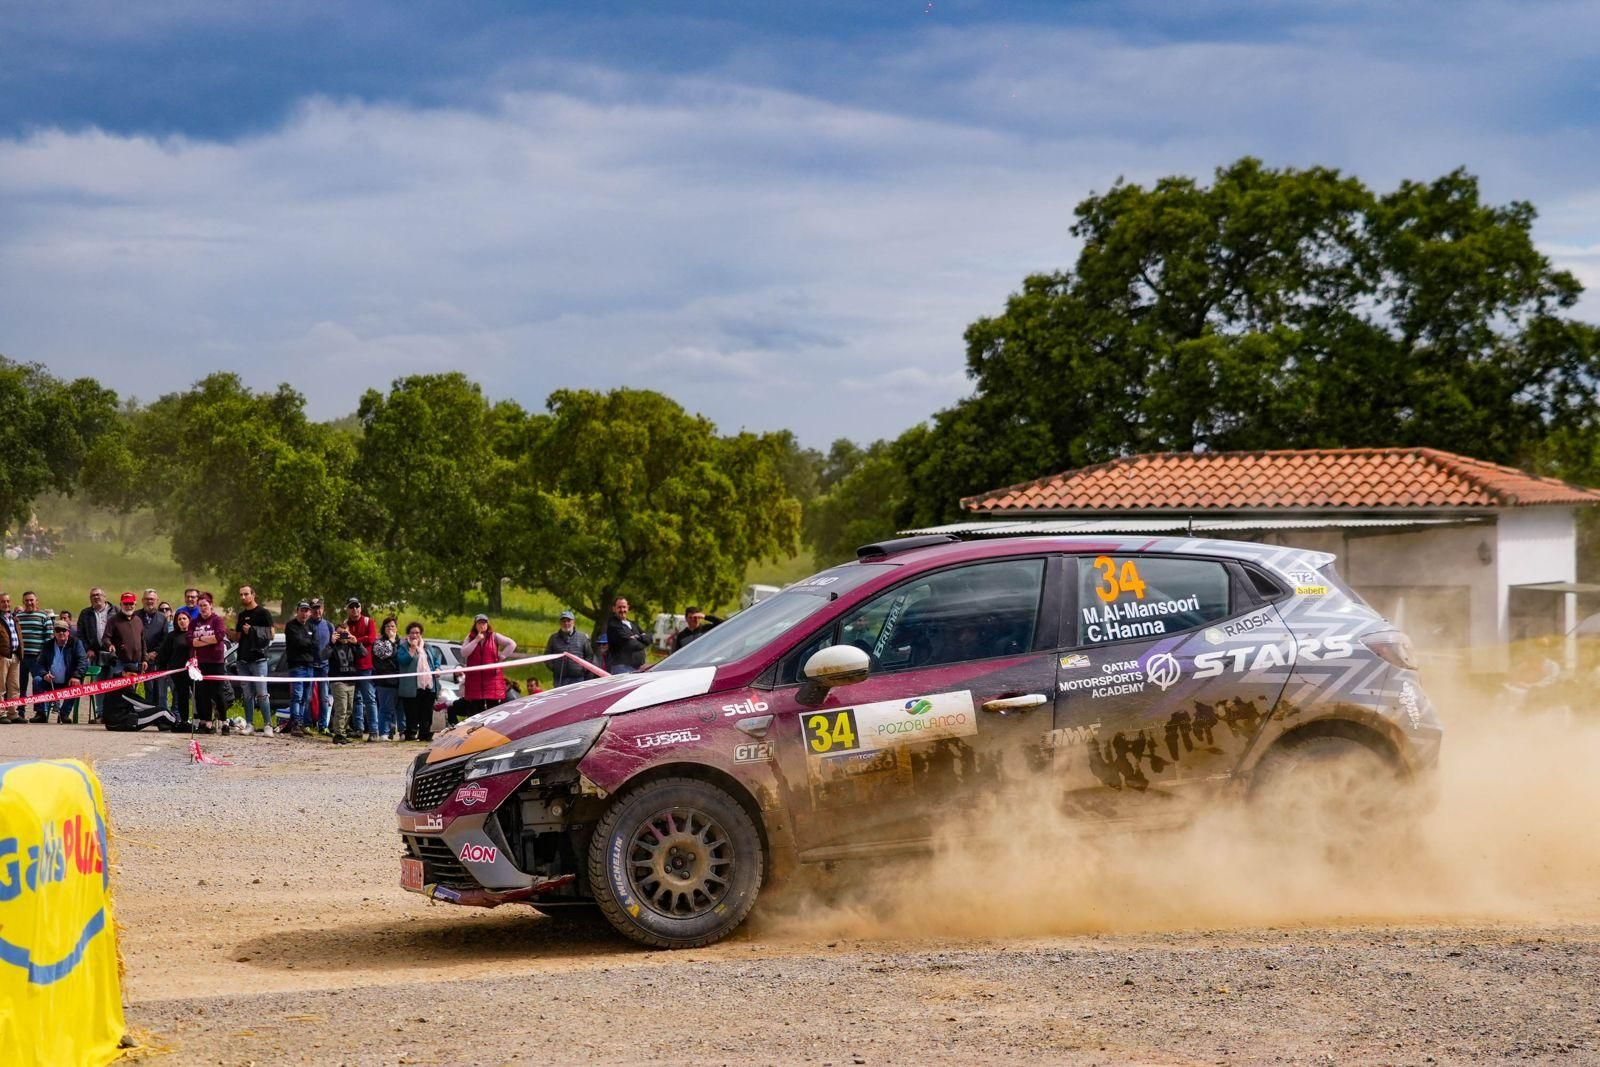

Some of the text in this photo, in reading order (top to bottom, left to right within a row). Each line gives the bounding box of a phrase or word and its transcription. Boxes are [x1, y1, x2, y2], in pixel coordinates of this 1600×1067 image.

[1093, 555, 1146, 603] 34
[1082, 594, 1200, 624] M.Al-Mansoori
[1087, 620, 1166, 642] C.Hanna
[1224, 612, 1273, 637] RADSA
[1102, 660, 1140, 674] QATAR
[1192, 634, 1353, 680] STARS
[83, 684, 99, 693] ZONA
[1059, 671, 1144, 692] MOTORSPORTS
[1092, 682, 1145, 699] ACADEMY
[808, 711, 855, 753] 34
[878, 713, 966, 736] POZOBLANCO
[460, 843, 497, 863] AON
[612, 836, 628, 897] MICHELIN
